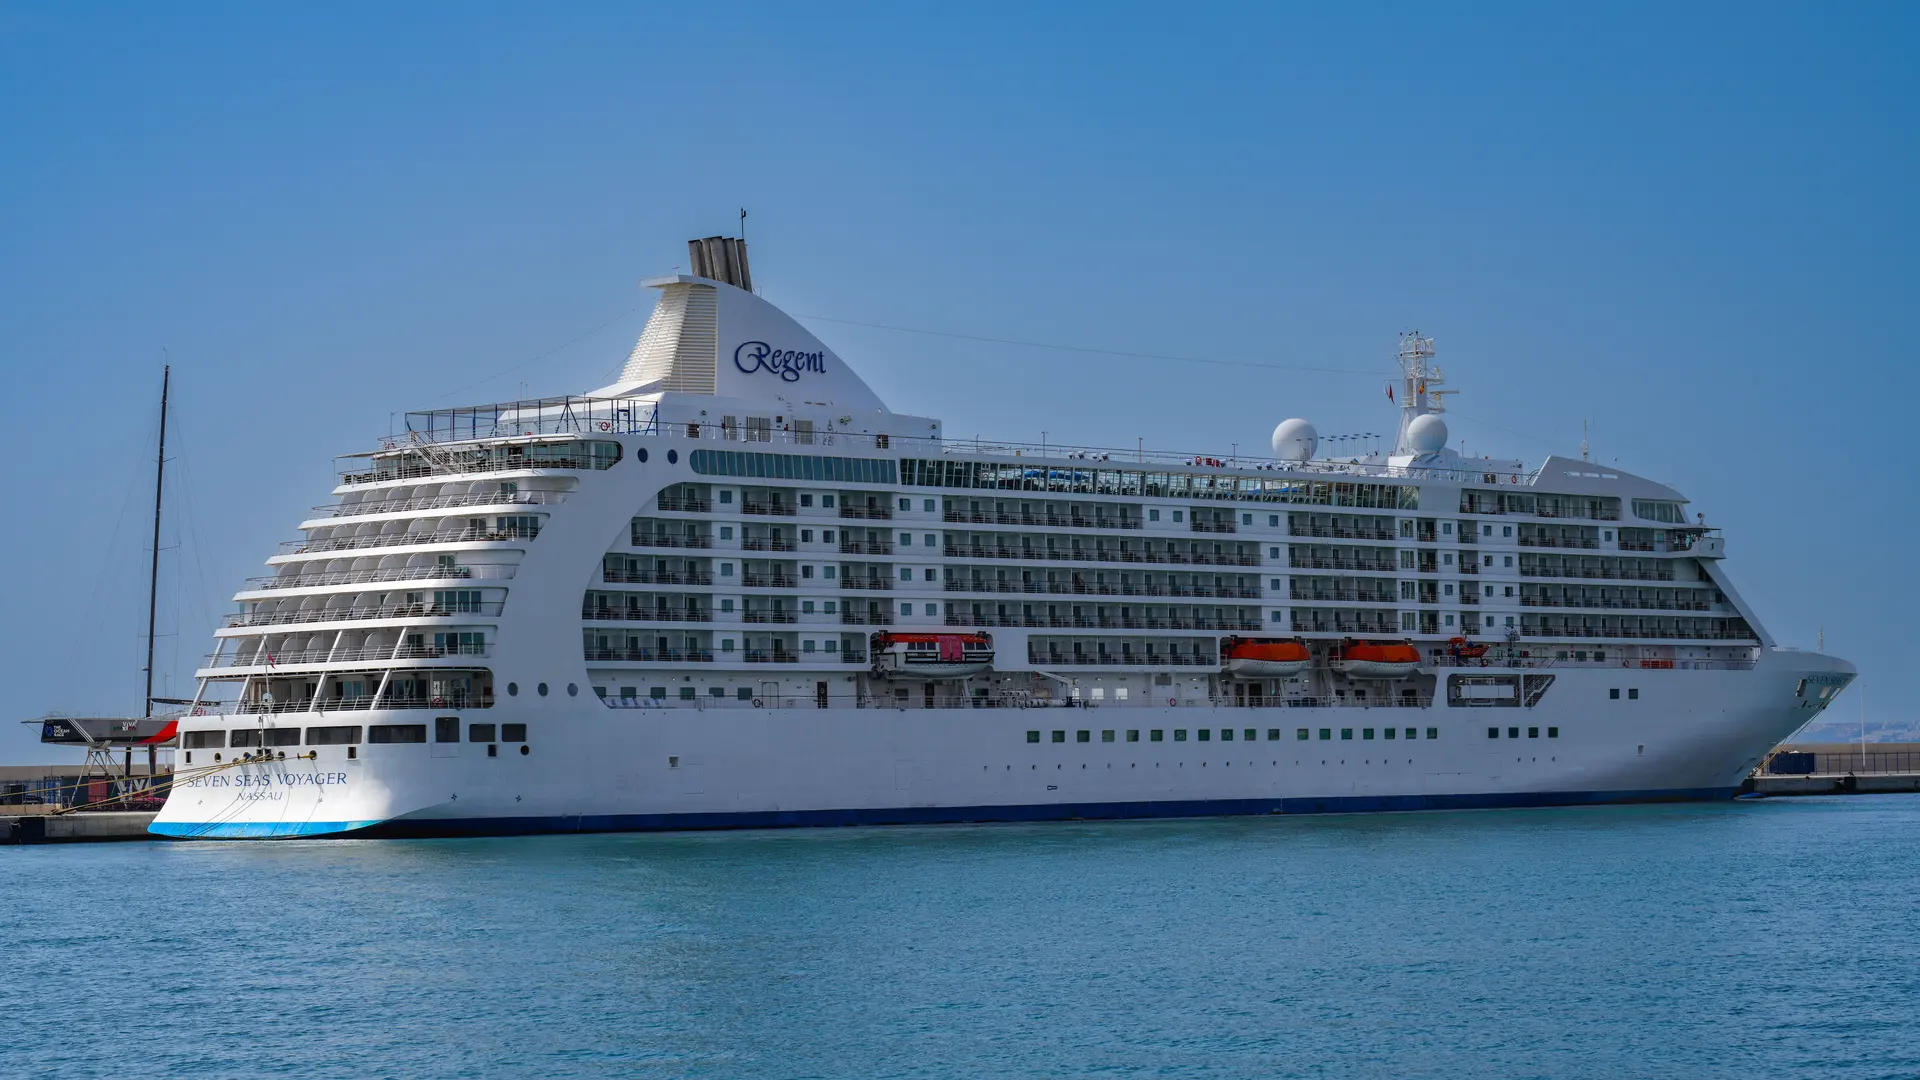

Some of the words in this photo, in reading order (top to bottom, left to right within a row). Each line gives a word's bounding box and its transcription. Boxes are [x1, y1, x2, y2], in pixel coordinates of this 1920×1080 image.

[734, 340, 827, 382] Regent
[187, 775, 231, 788] SEVEN
[234, 774, 270, 787] SEAS
[276, 772, 348, 786] VOYAGER
[236, 791, 283, 801] NASSAU
